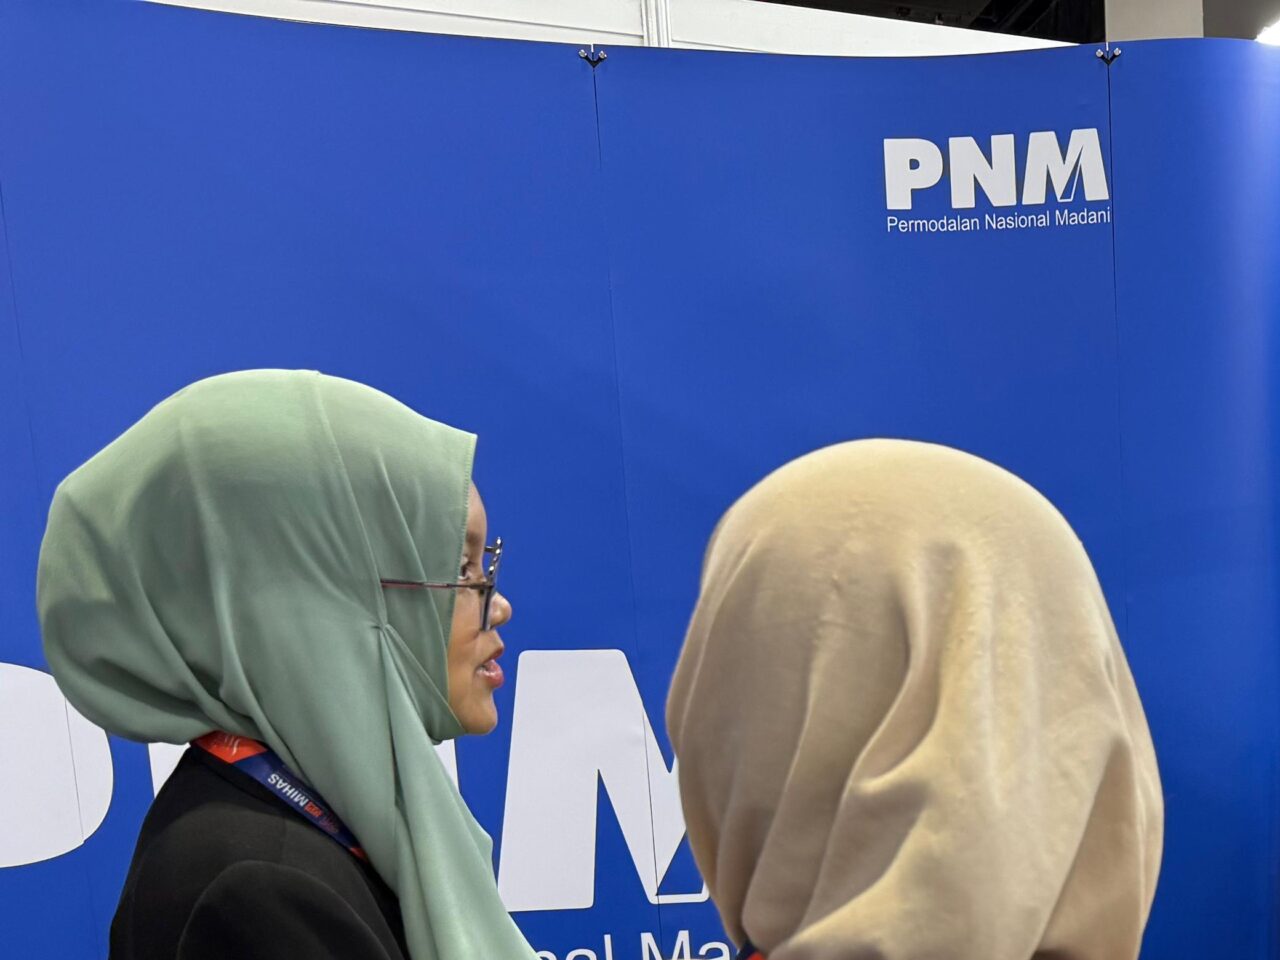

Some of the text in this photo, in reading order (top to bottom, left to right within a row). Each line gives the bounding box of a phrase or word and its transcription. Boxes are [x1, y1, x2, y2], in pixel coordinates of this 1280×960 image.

[883, 128, 1110, 210] PNM
[887, 206, 1111, 232] Permodalan Nasional Madani
[267, 773, 309, 807] MIHAS
